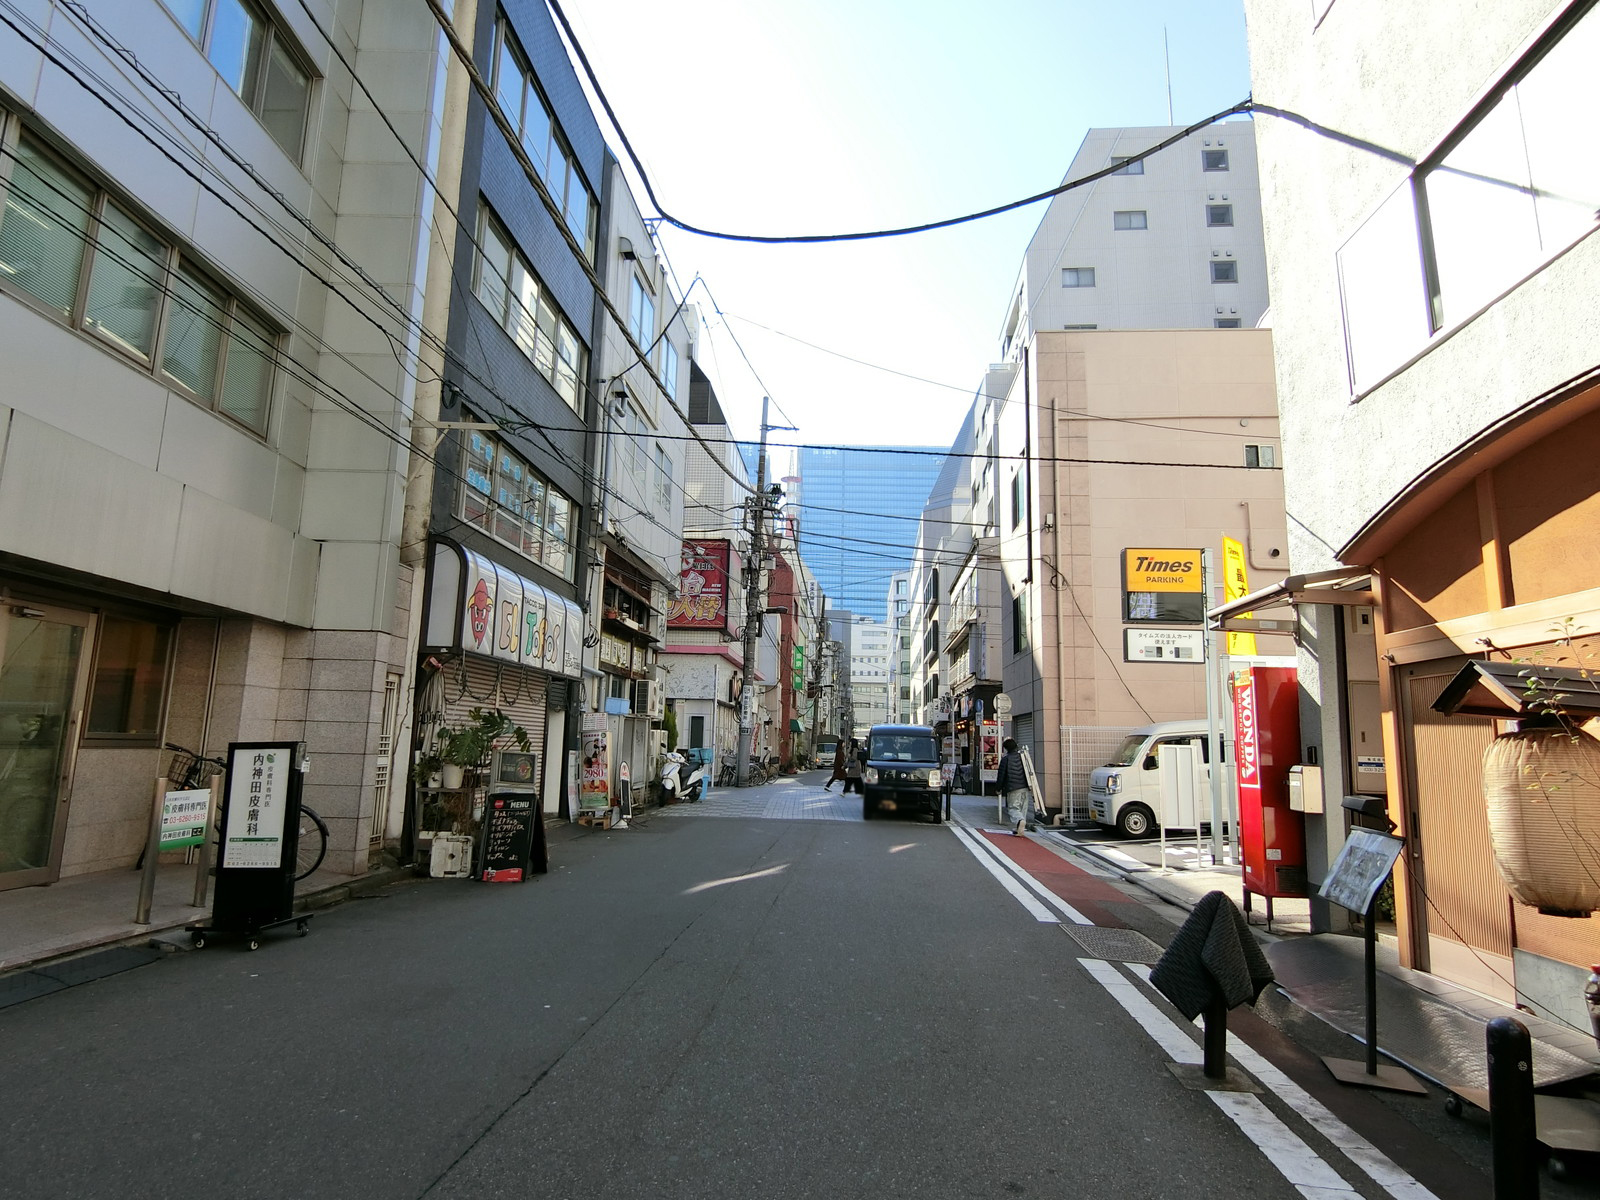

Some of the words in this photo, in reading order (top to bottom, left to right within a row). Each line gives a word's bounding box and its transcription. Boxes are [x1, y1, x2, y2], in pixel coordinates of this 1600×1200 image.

[1136, 557, 1194, 573] Times
[1146, 576, 1184, 584] PARKING
[1241, 686, 1256, 778] WONDA
[583, 768, 604, 779] 2980
[264, 765, 274, 808] 皮膚科専門医
[246, 753, 265, 836] 内神田皮膚科
[171, 801, 207, 813] 皮膚科専門医
[162, 830, 191, 840] 内神田皮膚科
